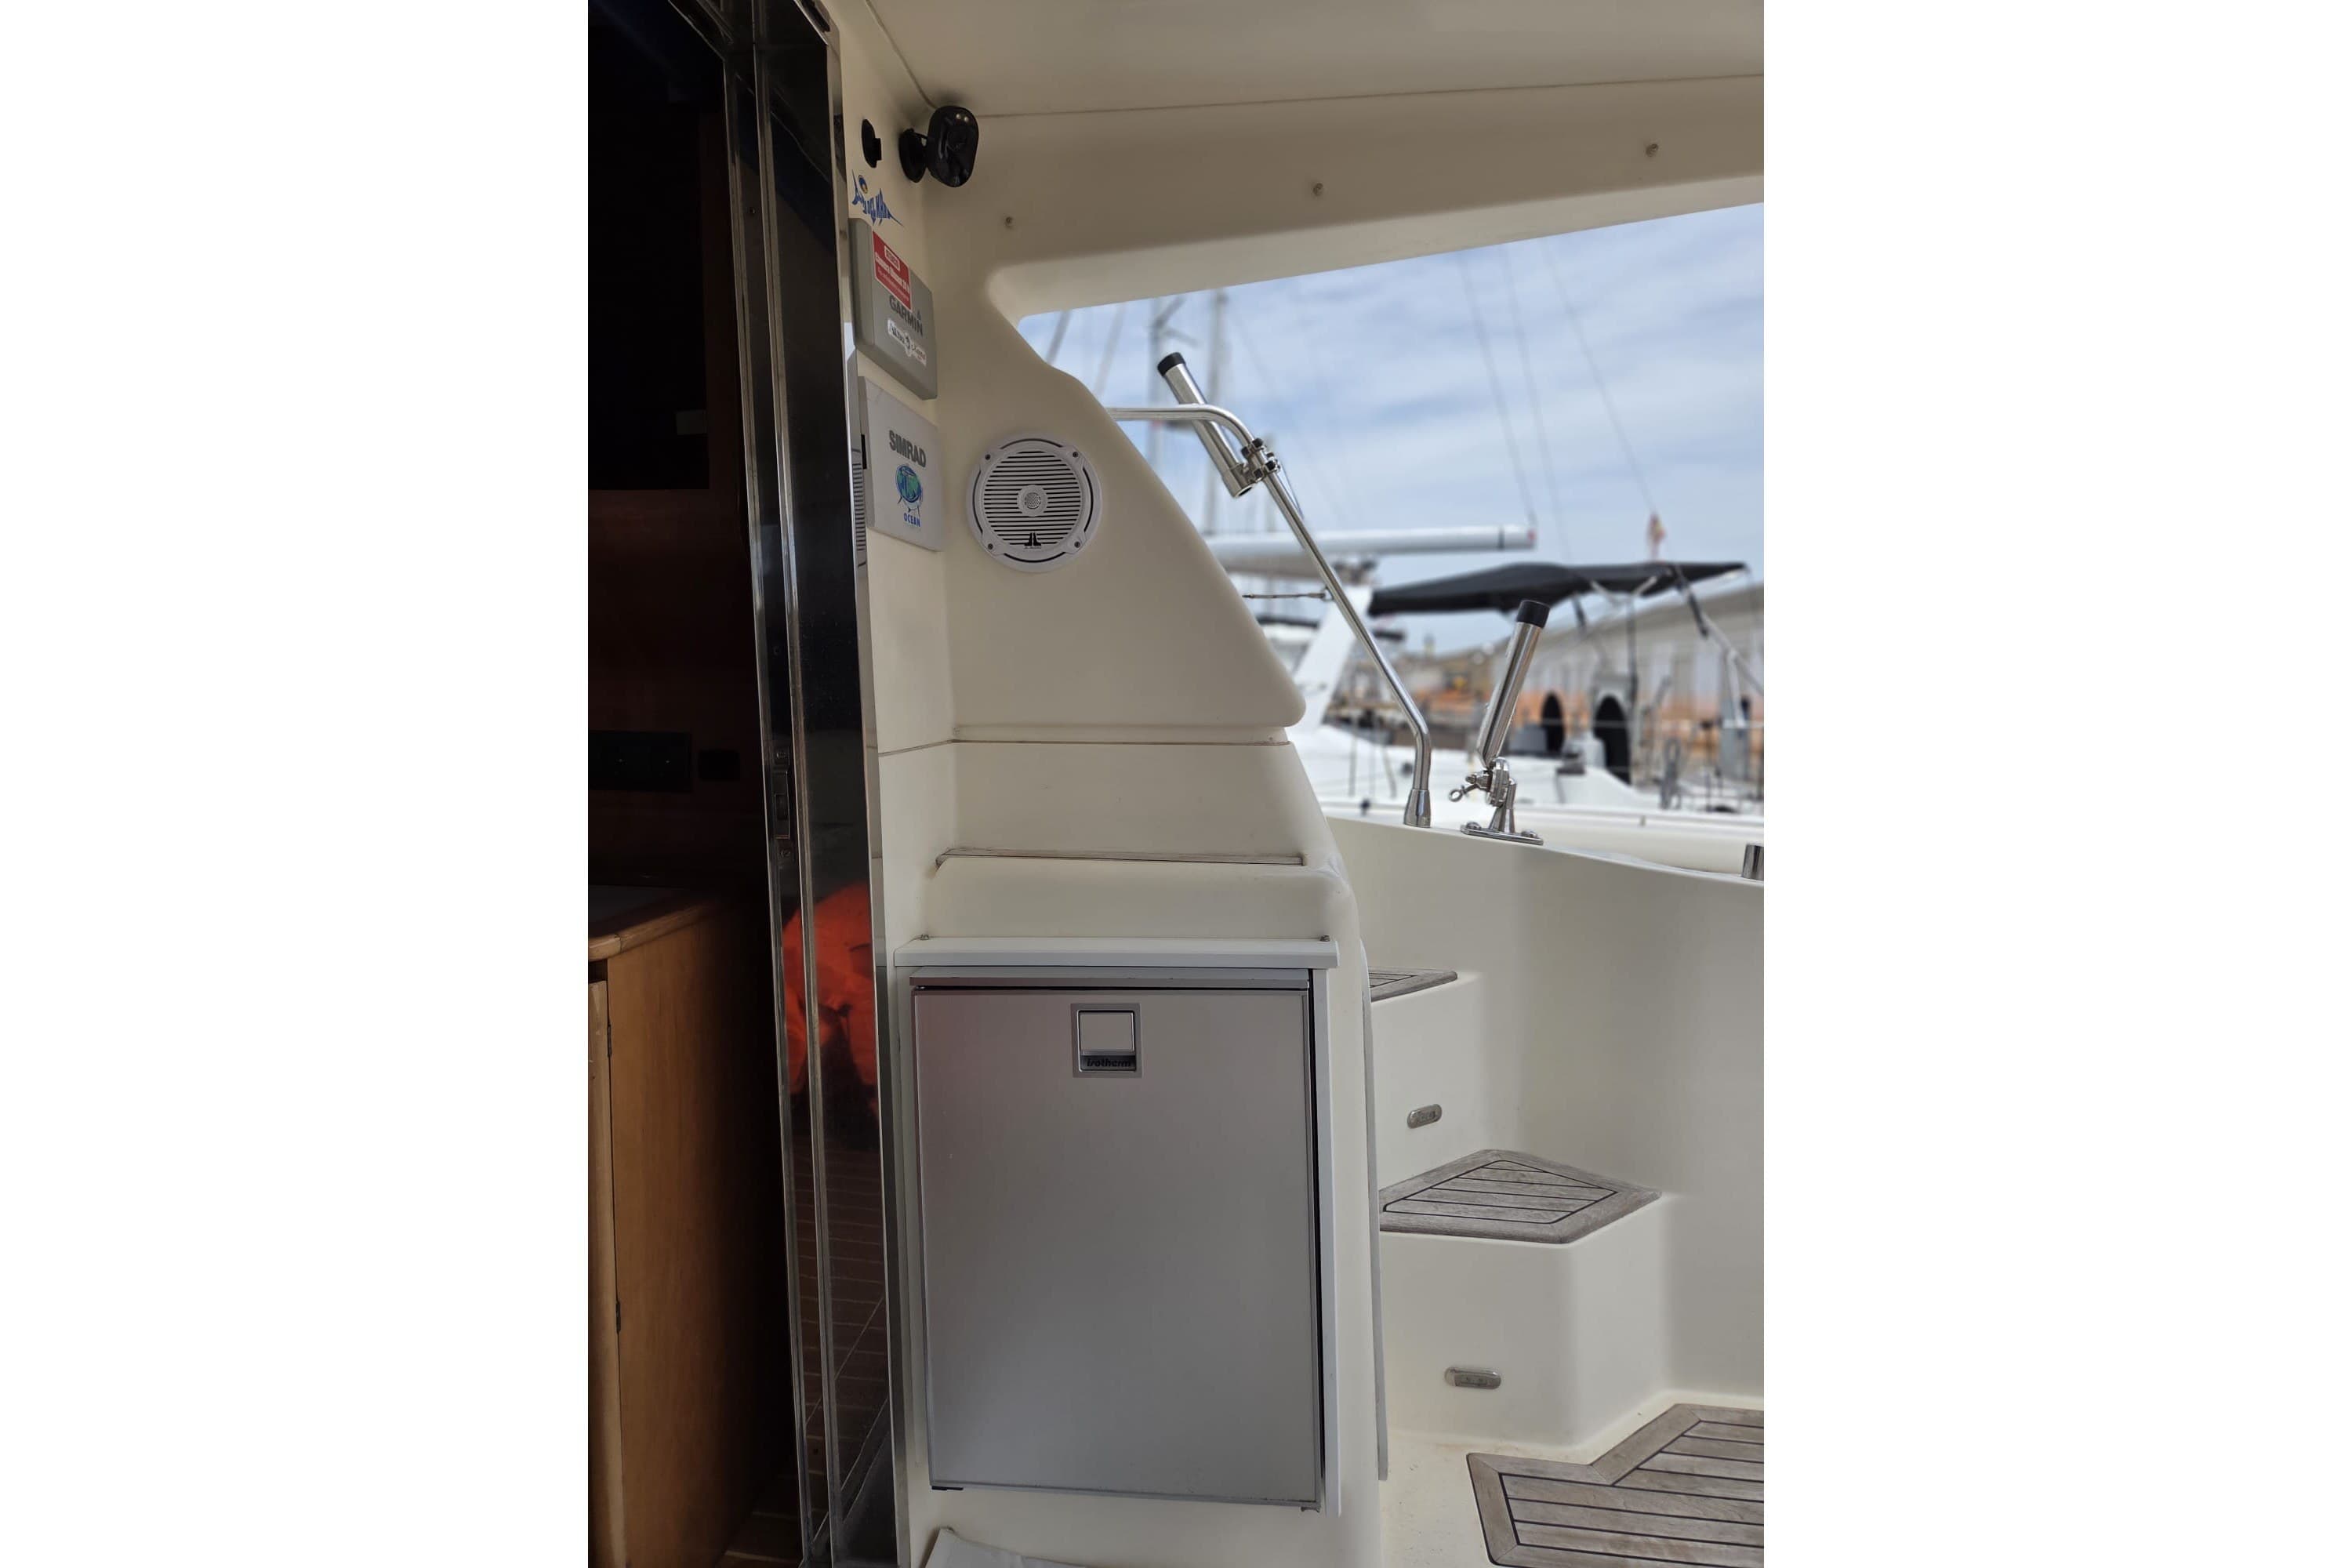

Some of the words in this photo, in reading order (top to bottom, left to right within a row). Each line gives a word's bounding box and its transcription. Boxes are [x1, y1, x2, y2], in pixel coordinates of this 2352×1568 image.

[889, 295, 923, 336] GARMIN
[889, 430, 927, 468] SIMRAD
[903, 513, 921, 528] OCEAN
